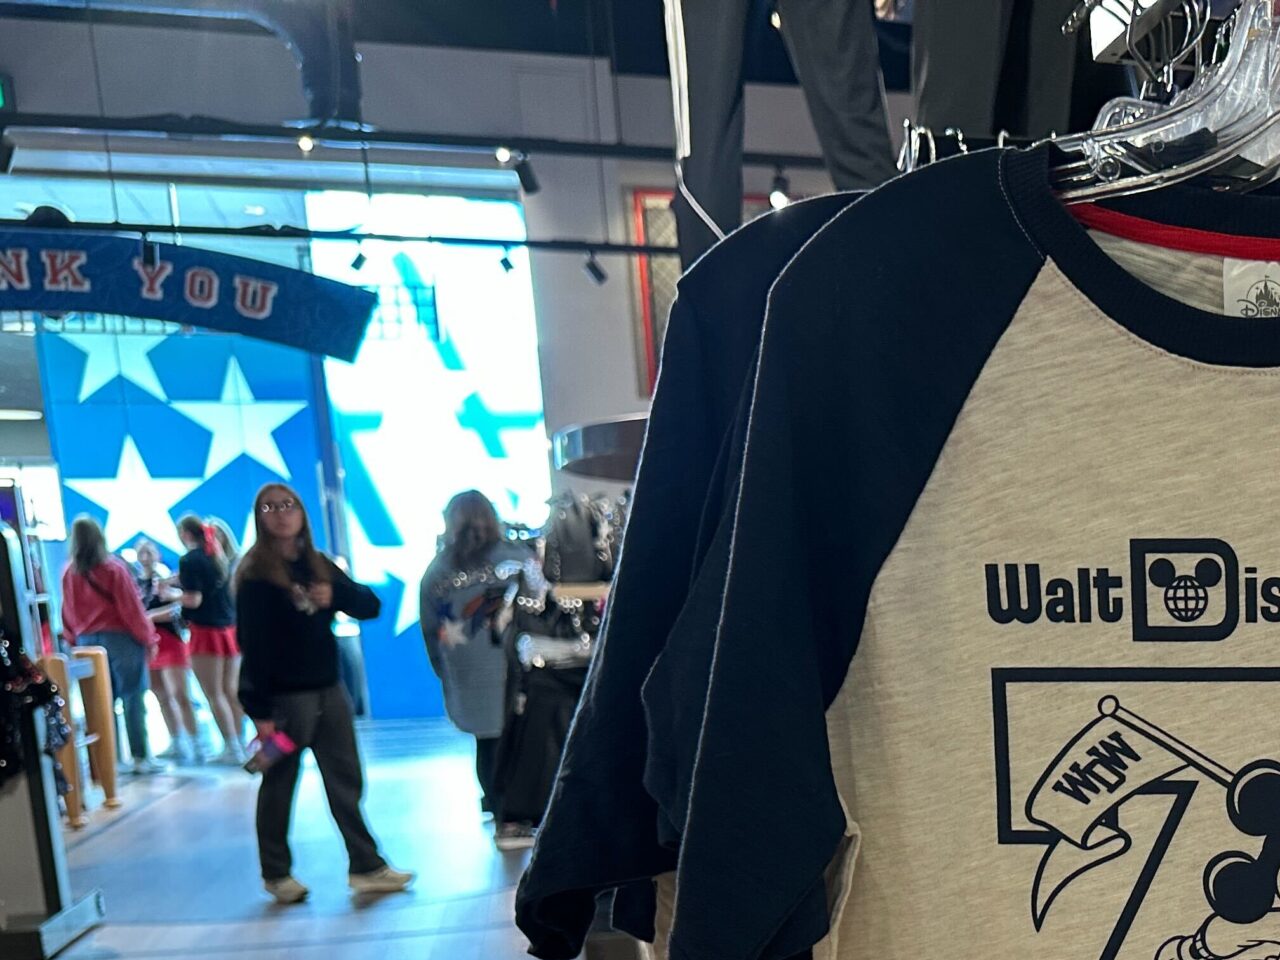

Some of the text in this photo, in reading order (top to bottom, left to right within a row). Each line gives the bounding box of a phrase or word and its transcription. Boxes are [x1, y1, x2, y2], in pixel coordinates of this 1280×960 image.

[133, 257, 278, 320] YOU
[985, 563, 1123, 624] Walt
[1052, 731, 1142, 805] WDW
